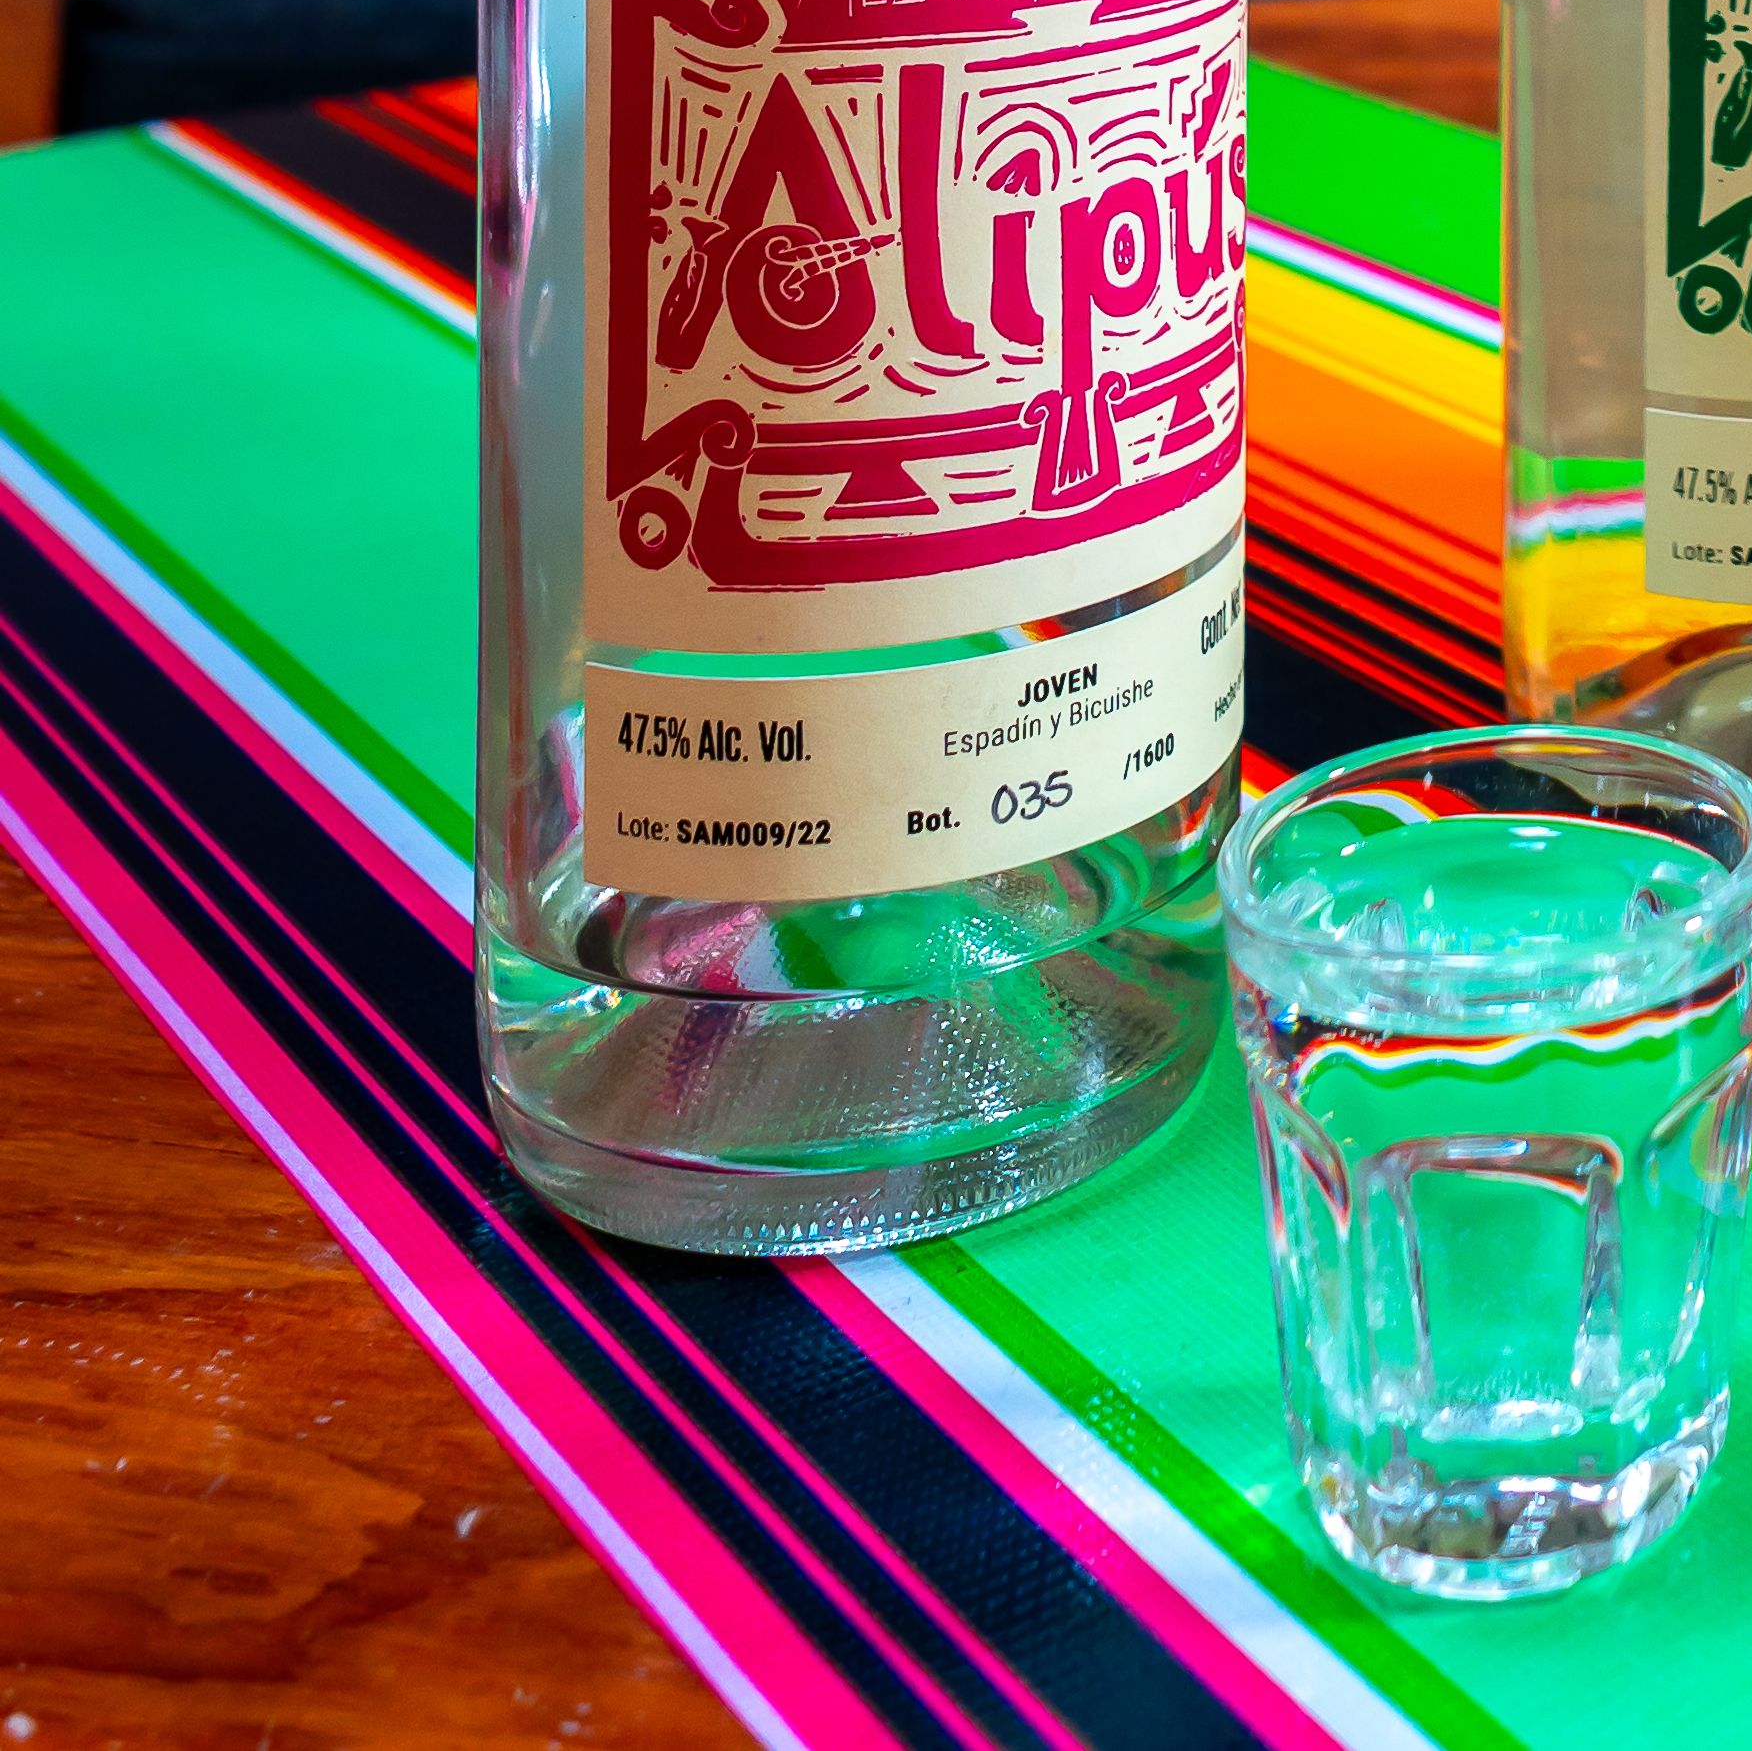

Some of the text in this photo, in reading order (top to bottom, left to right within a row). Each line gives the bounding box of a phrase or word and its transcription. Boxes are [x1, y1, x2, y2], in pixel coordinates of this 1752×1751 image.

[1671, 466, 1738, 506] 47.5%
[1671, 540, 1724, 565] Lote:
[1017, 662, 1098, 708] JOVEN
[617, 711, 812, 763] 47.5% Alc. Vol.
[944, 677, 1154, 757] Espadín y Bicuishe
[617, 732, 1176, 849] Lote: SAM009/22 Bot. 035 /1600
